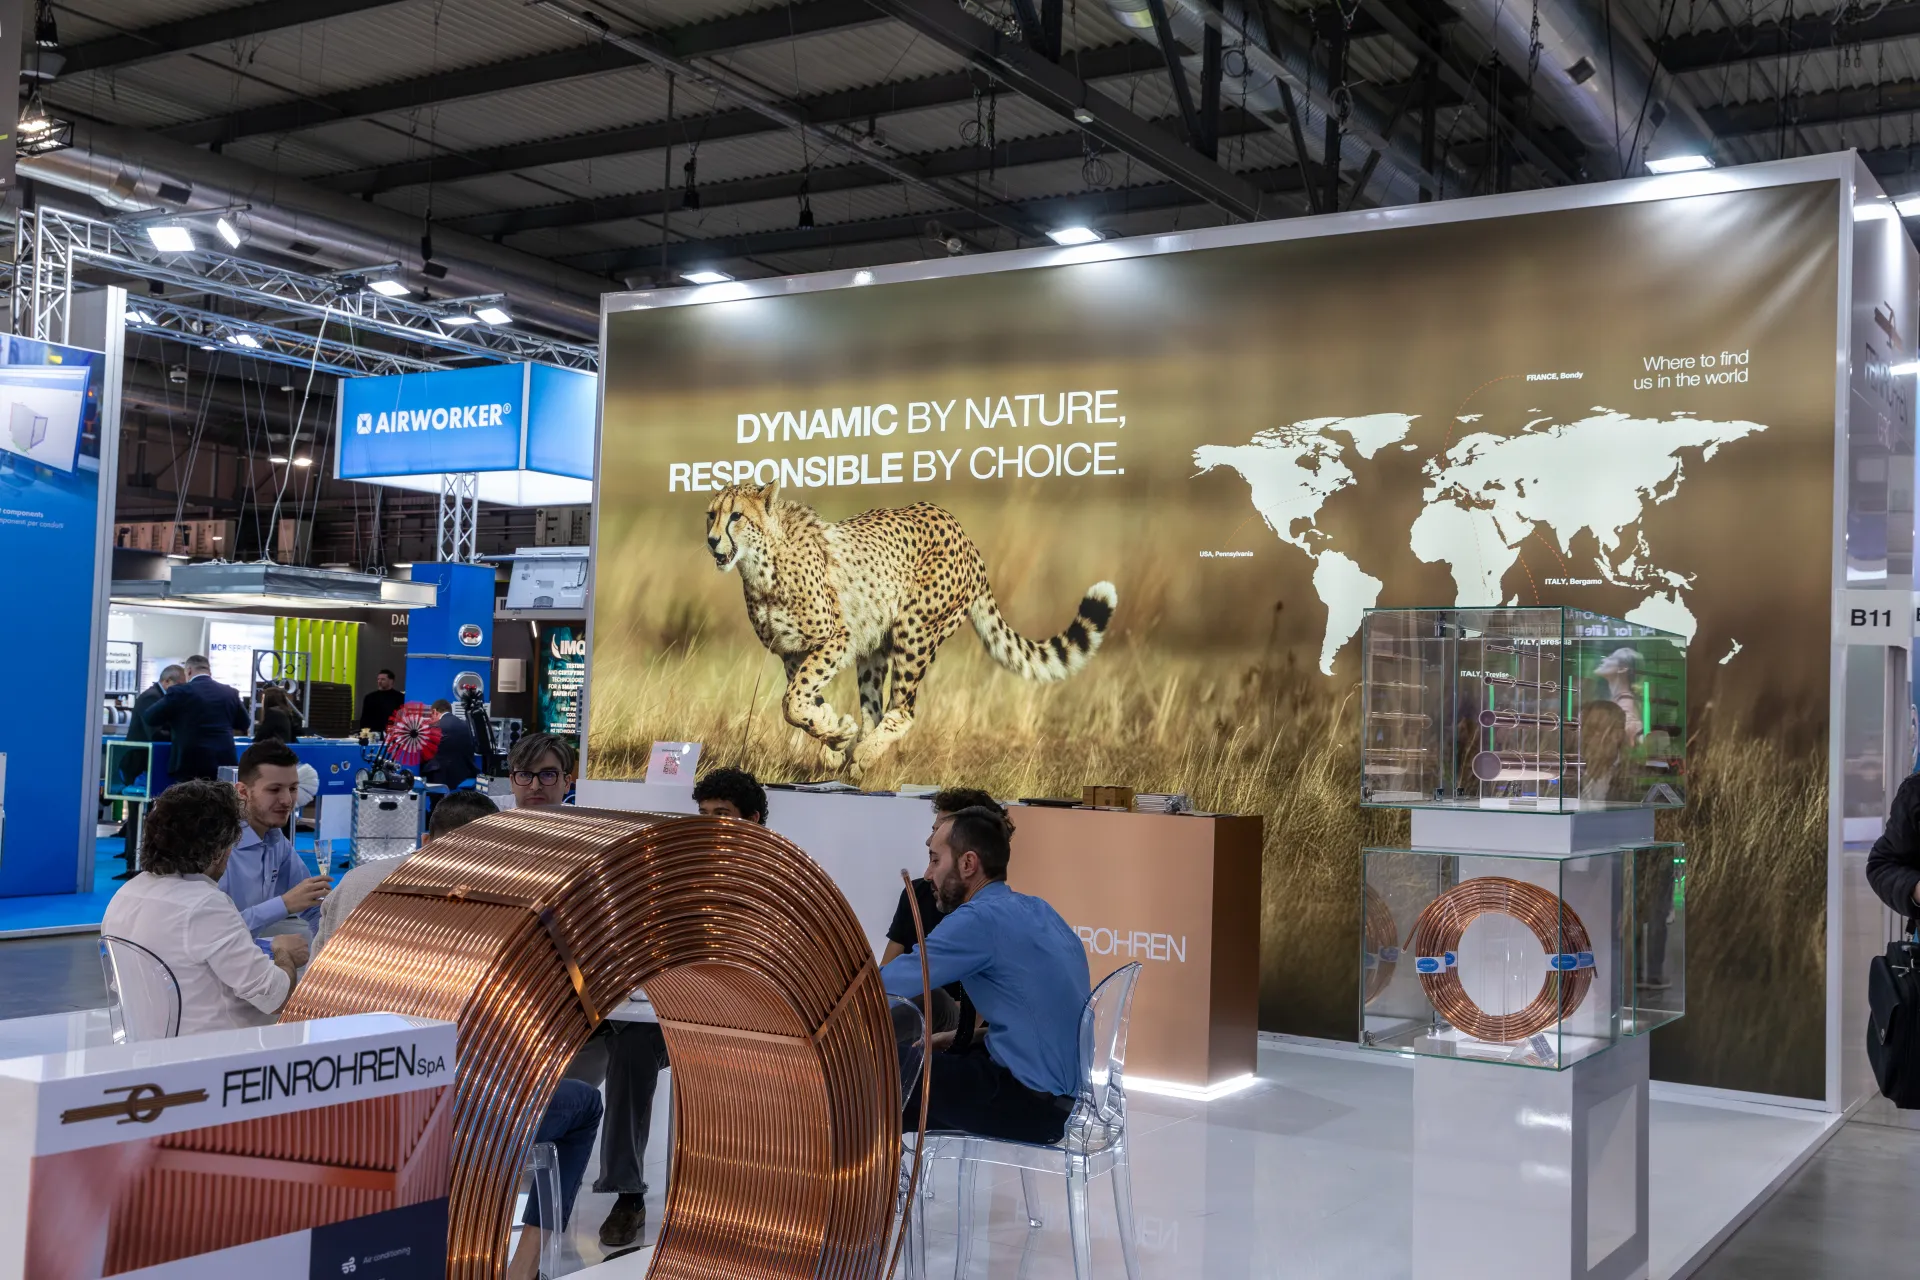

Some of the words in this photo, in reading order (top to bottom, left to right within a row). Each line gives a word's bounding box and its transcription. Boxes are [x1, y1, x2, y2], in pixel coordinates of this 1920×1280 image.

[1643, 356, 1695, 371] Where
[1700, 353, 1715, 368] to
[1720, 349, 1749, 366] find
[1526, 373, 1559, 381] FRANCE,
[1560, 371, 1584, 380] Bondy
[1634, 377, 1652, 389] us
[1657, 374, 1671, 388] in
[1675, 372, 1700, 387] the
[1705, 368, 1749, 385] world
[737, 404, 898, 443] DYNAMIC
[907, 399, 956, 433] BY
[965, 390, 1126, 429] NATURE,
[669, 452, 903, 492] RESPONSIBLE
[913, 449, 962, 482] BY
[969, 442, 1125, 479] CHOICE.
[1544, 578, 1569, 586] ITALY,
[1569, 578, 1603, 586] Bergamo
[1851, 609, 1891, 627] B11
[560, 640, 585, 655] IMQ
[1541, 638, 1572, 646] Bresia
[1073, 925, 1186, 963] ROHREN
[222, 1043, 417, 1108] FEINROHREN
[417, 1055, 446, 1078] SpA
[374, 1247, 411, 1263] conditioning
